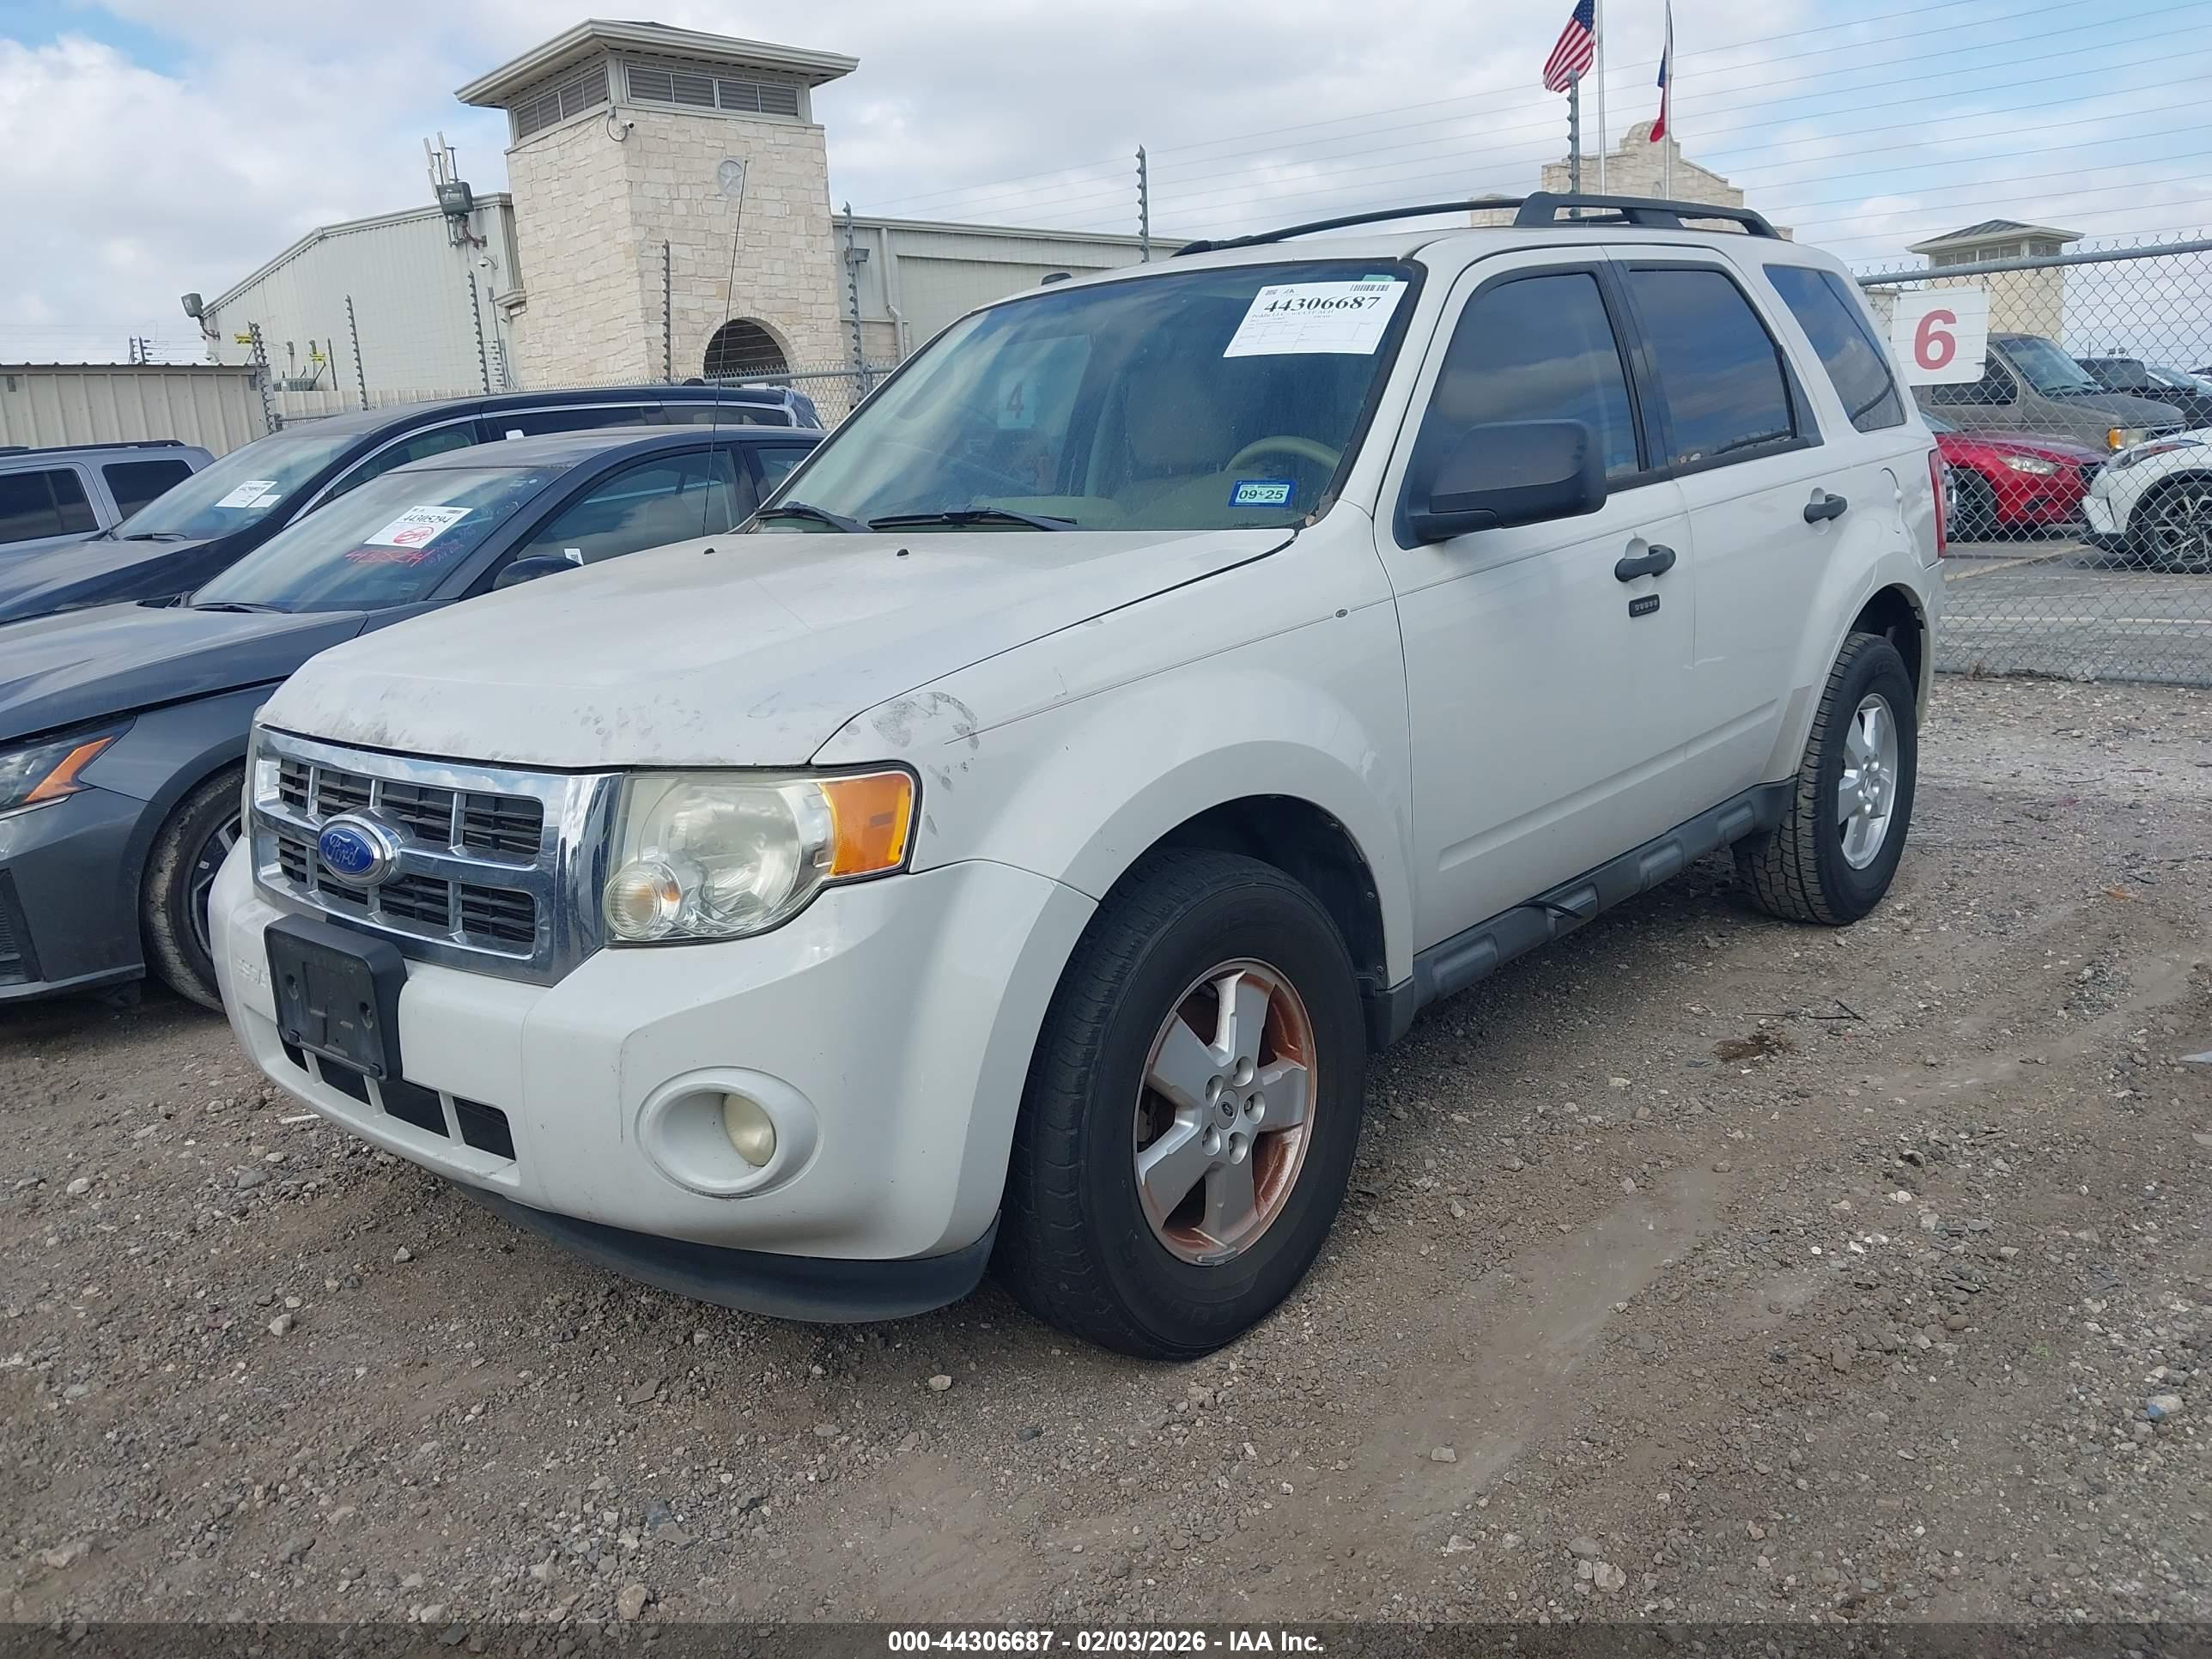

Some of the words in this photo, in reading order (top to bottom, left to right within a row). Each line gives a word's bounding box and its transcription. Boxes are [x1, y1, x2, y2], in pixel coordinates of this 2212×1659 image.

[1264, 296, 1382, 313] 44306687
[1914, 309, 1957, 370] 6
[1006, 382, 1024, 420] 4
[1239, 489, 1258, 500] 09
[1264, 489, 1285, 500] 25
[326, 833, 360, 866] Ford
